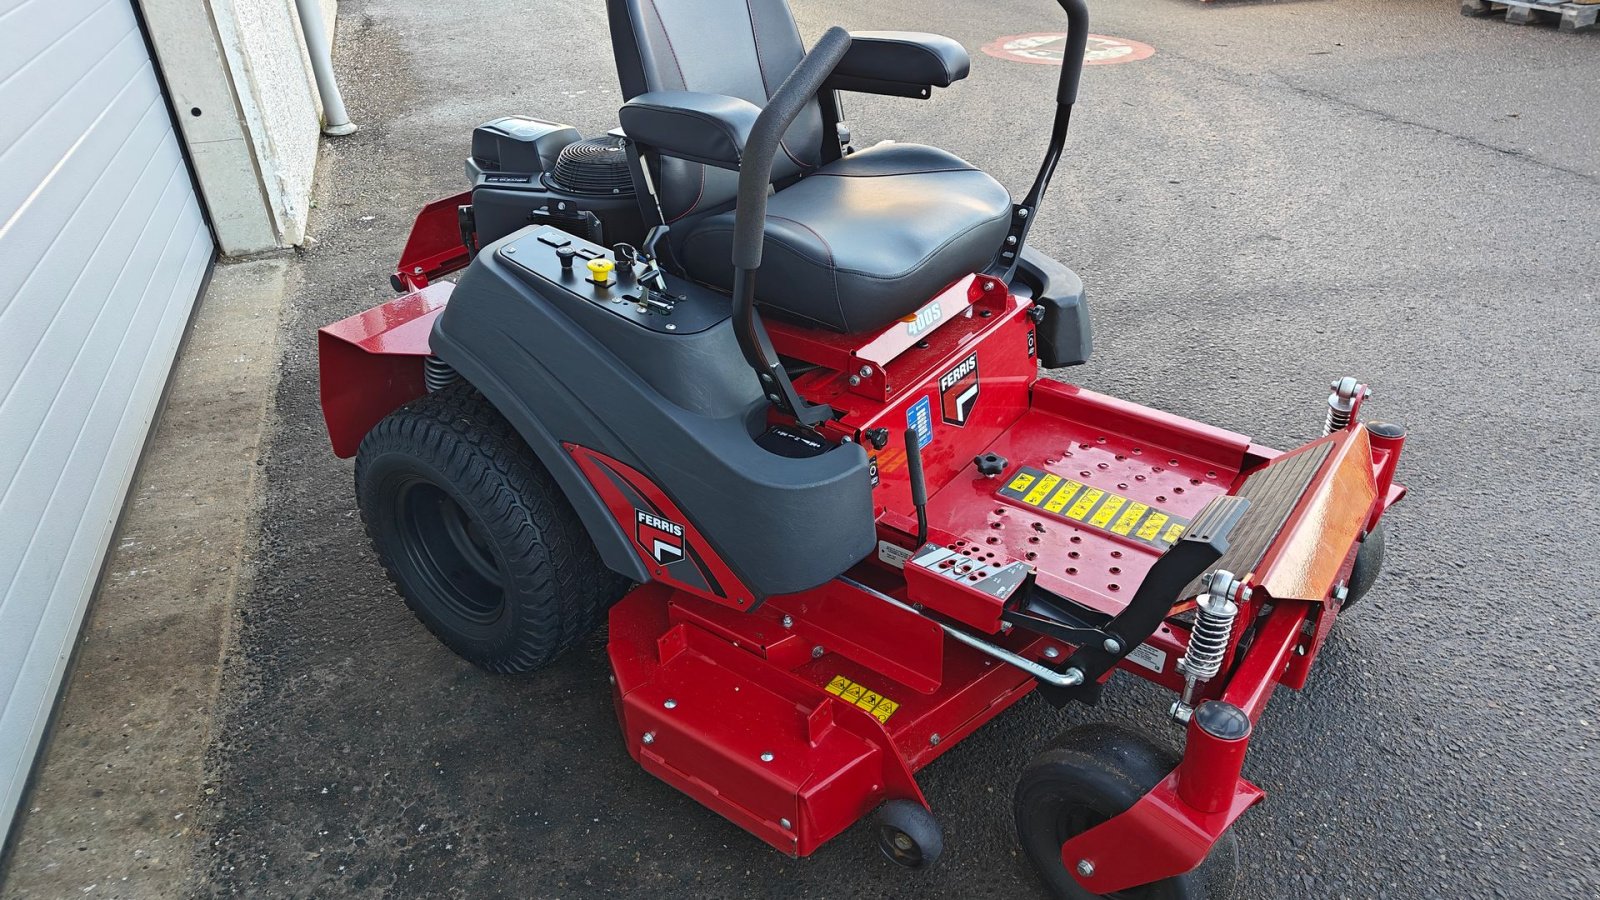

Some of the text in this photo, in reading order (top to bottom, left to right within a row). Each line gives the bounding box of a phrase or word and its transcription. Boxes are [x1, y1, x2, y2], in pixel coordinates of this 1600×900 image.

[908, 302, 942, 335] 400S
[941, 355, 977, 391] FERRIS
[638, 511, 682, 536] FERRIS
